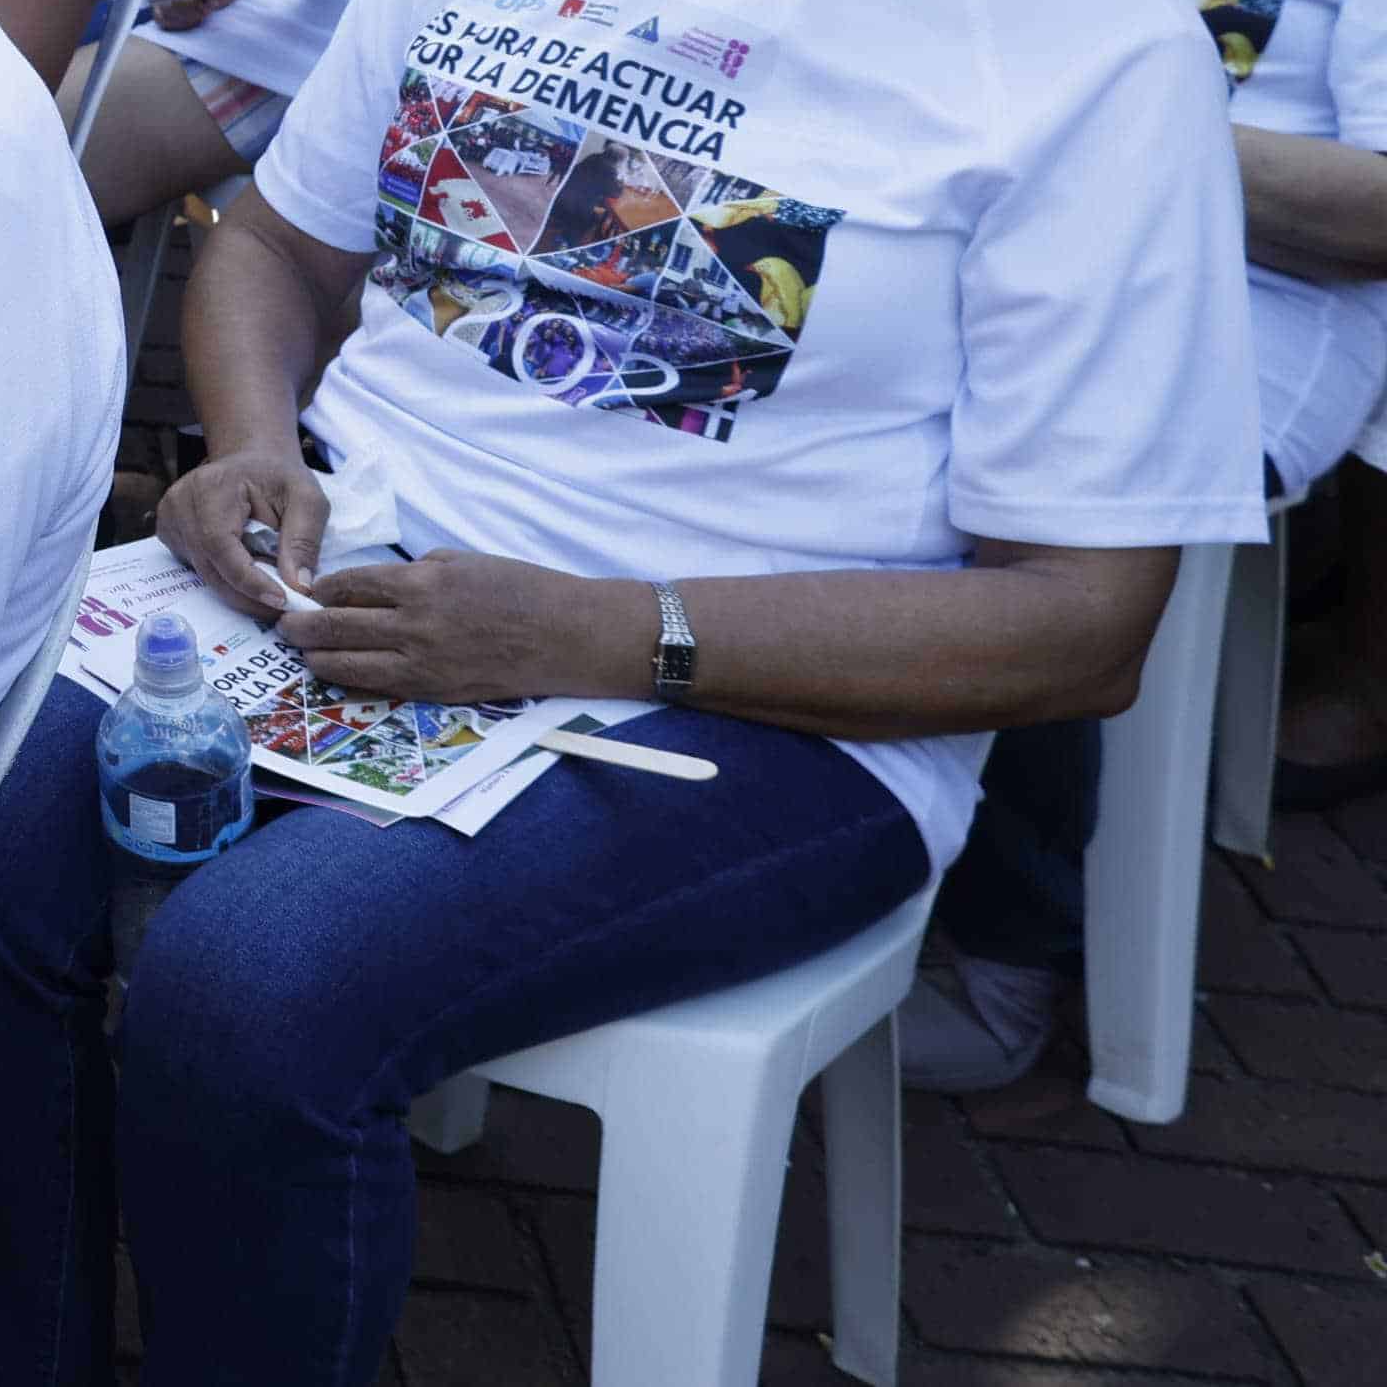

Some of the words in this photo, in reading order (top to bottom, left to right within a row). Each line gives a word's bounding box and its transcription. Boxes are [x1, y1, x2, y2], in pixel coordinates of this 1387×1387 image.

[464, 55, 506, 88] LA
[510, 68, 725, 162] DEMENCIA
[538, 39, 585, 69] DE
[582, 51, 746, 129] ACTUAR
[213, 665, 256, 691] ORA
[248, 649, 279, 669] DE
[241, 680, 275, 699] LA
